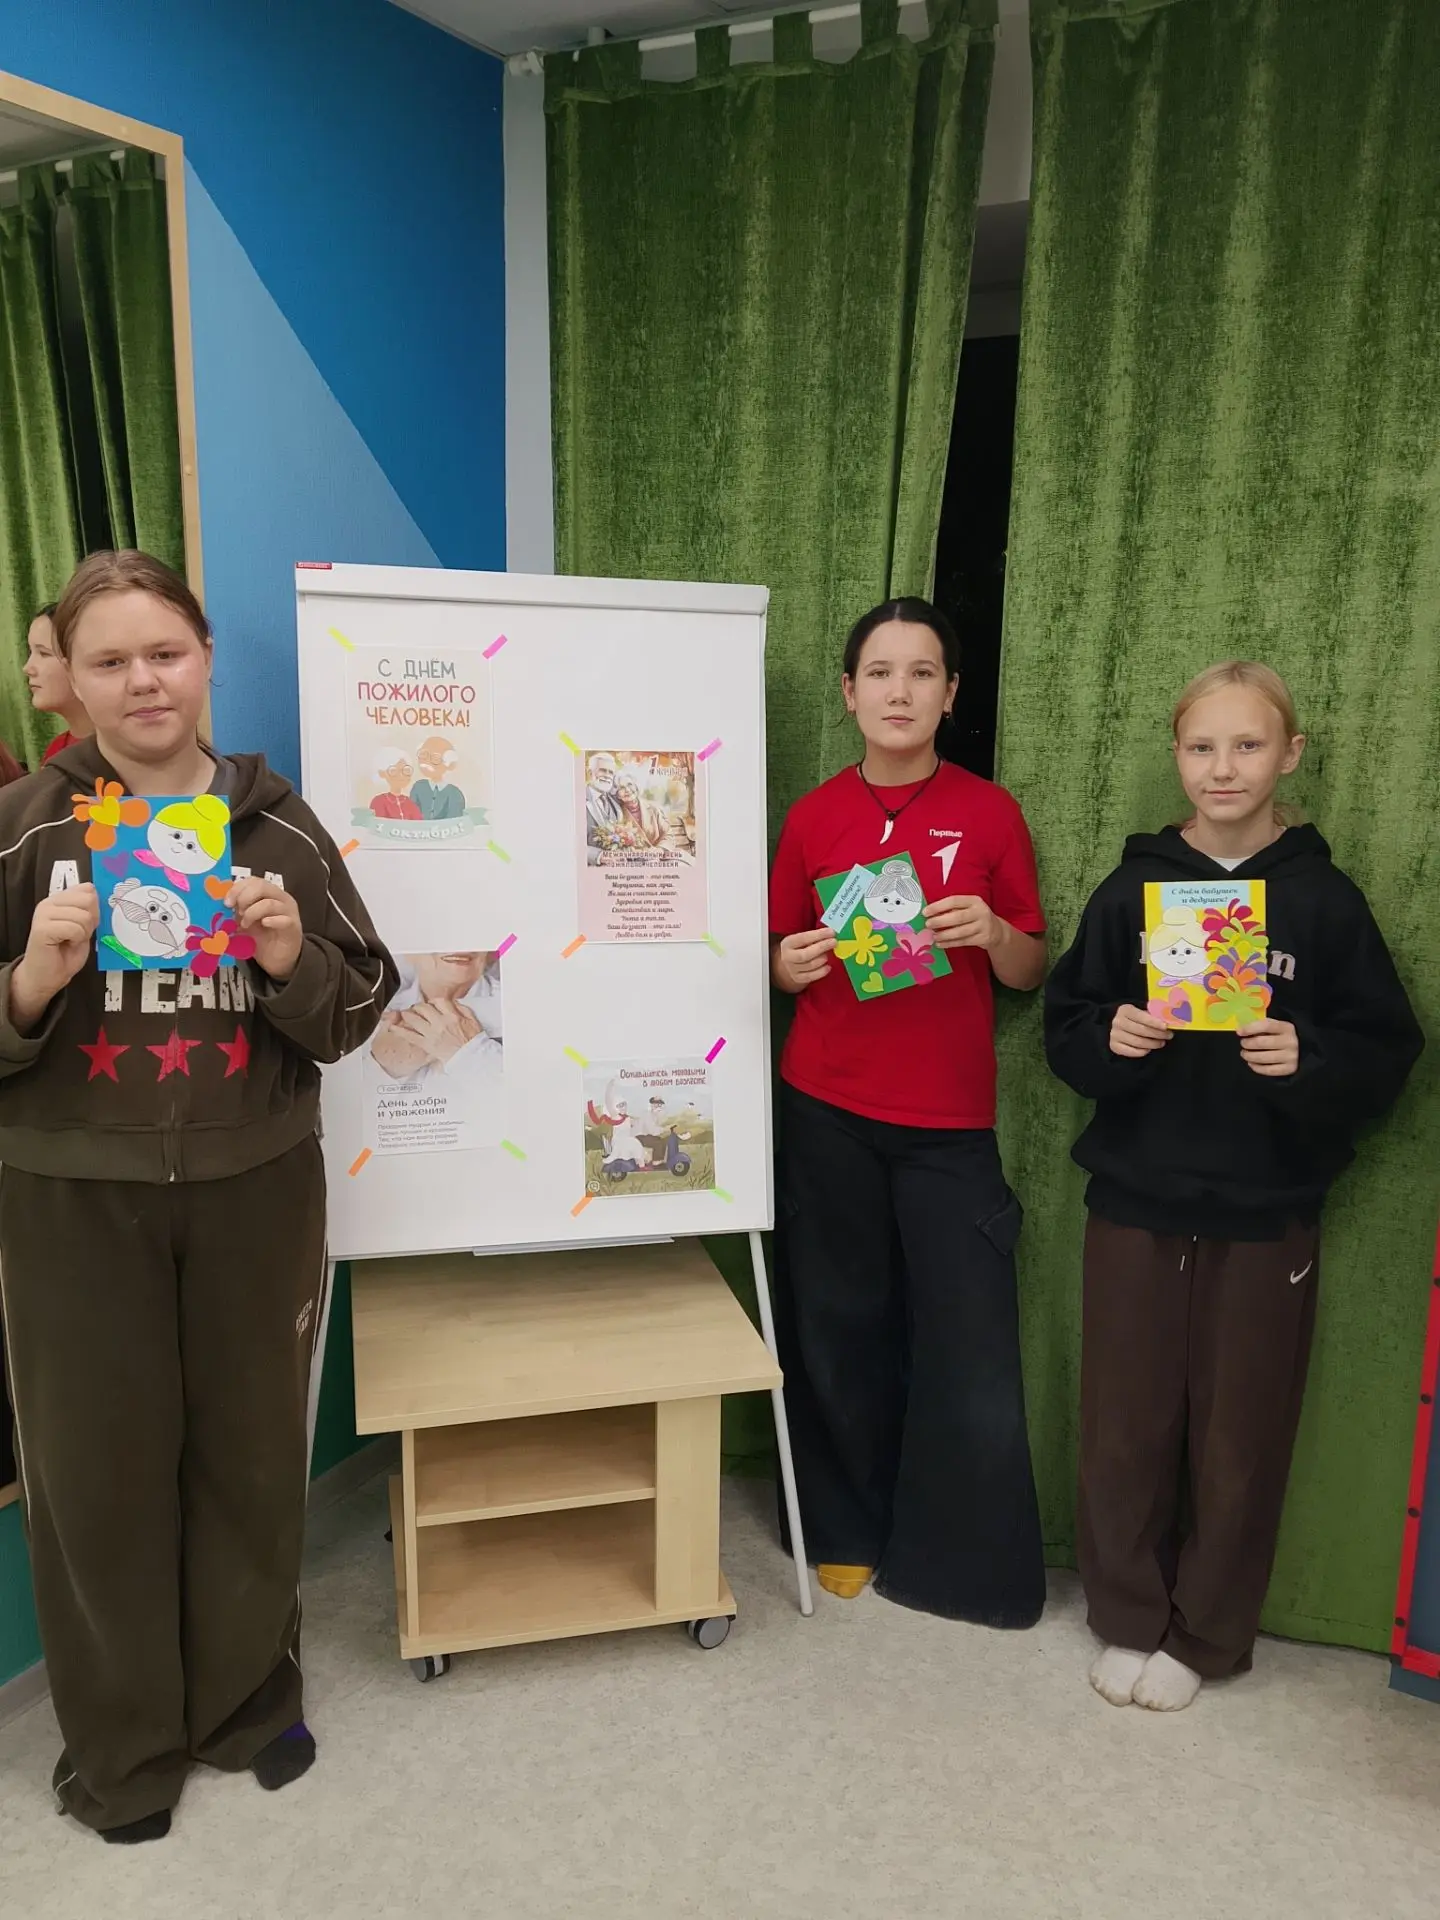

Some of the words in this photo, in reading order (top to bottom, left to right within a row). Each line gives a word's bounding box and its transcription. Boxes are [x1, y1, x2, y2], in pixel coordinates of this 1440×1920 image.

[378, 658, 392, 677] С
[403, 657, 456, 680] ДНЁМ
[358, 682, 476, 704] ПОЖИЛОГО
[366, 706, 470, 728] ЧЕЛОВЕКА!
[377, 1099, 408, 1109] День
[411, 1096, 447, 1107] добра
[389, 1107, 445, 1119] уважения
